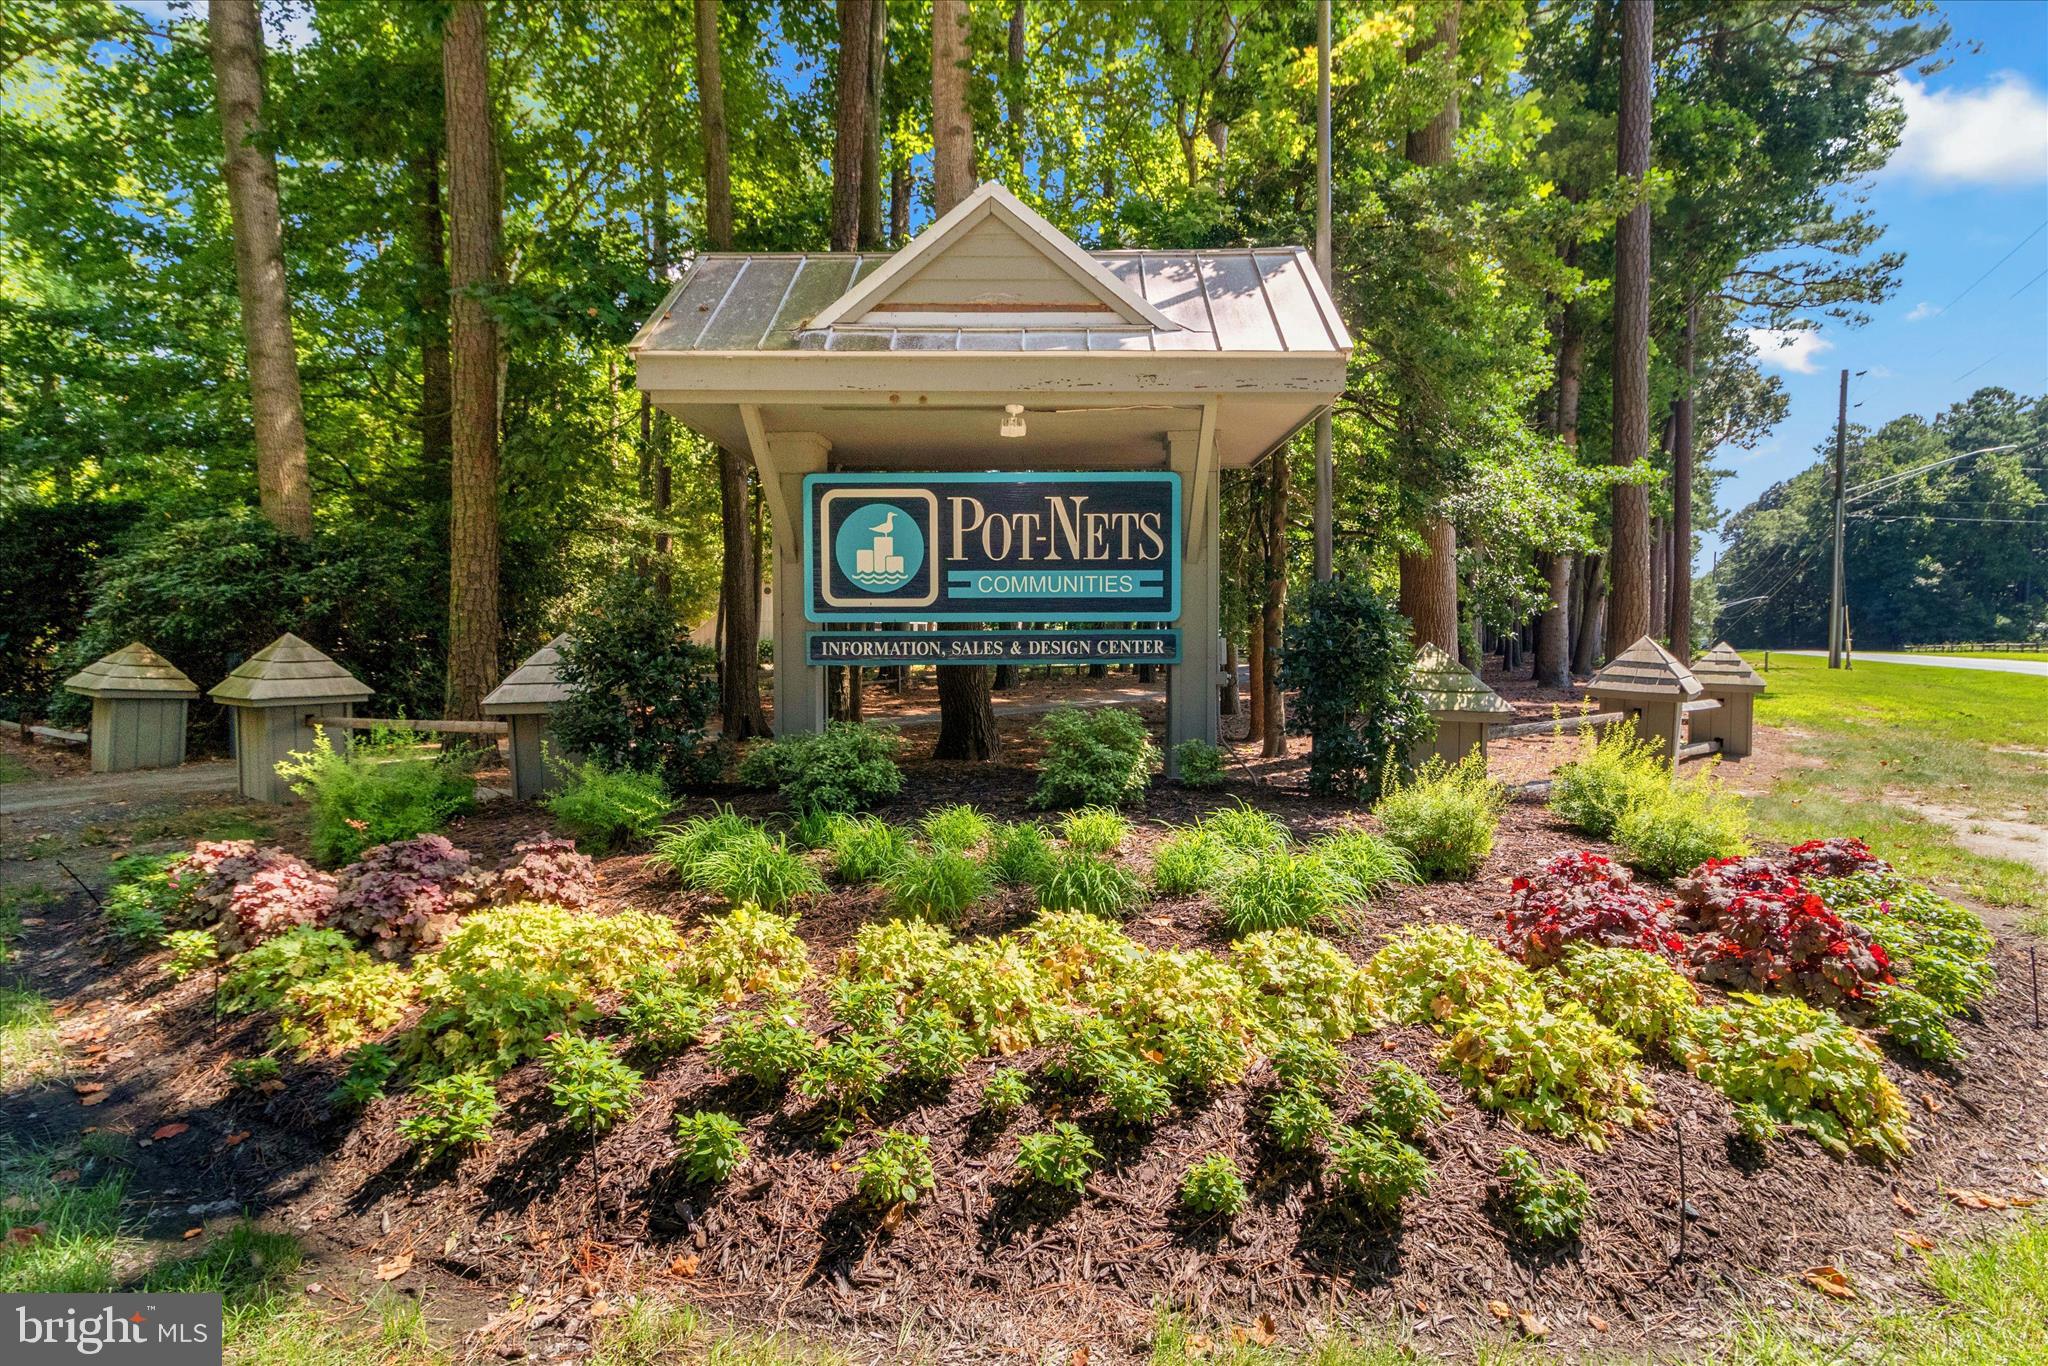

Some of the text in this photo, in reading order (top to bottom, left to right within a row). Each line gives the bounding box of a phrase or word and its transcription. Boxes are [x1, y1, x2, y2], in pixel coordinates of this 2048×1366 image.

[947, 496, 1164, 561] POT-NETS
[978, 575, 1133, 593] COMMUNITIES
[821, 639, 1164, 658] INFORMATION, SALES & DESIGN CENTER
